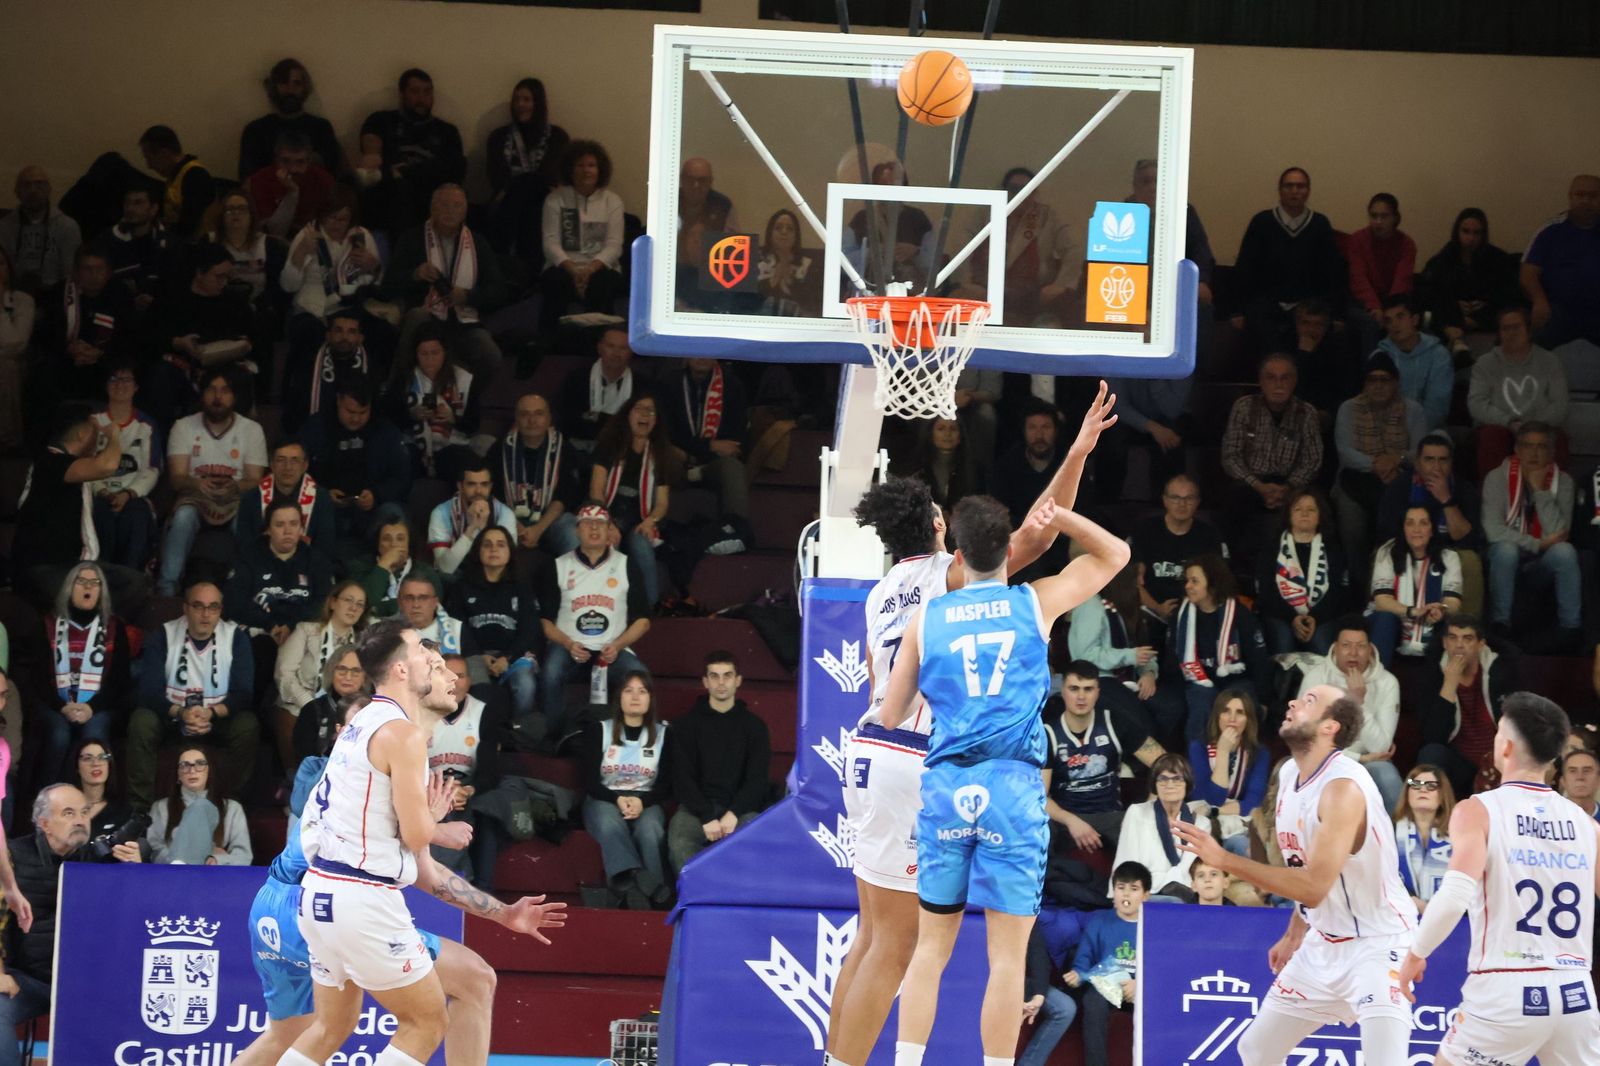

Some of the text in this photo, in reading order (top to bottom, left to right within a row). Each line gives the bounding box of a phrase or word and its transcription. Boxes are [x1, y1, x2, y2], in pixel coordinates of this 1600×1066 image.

[945, 600, 1012, 623] NASPLER
[949, 630, 1016, 697] 17
[1515, 879, 1581, 939] 28
[354, 1008, 399, 1036] de
